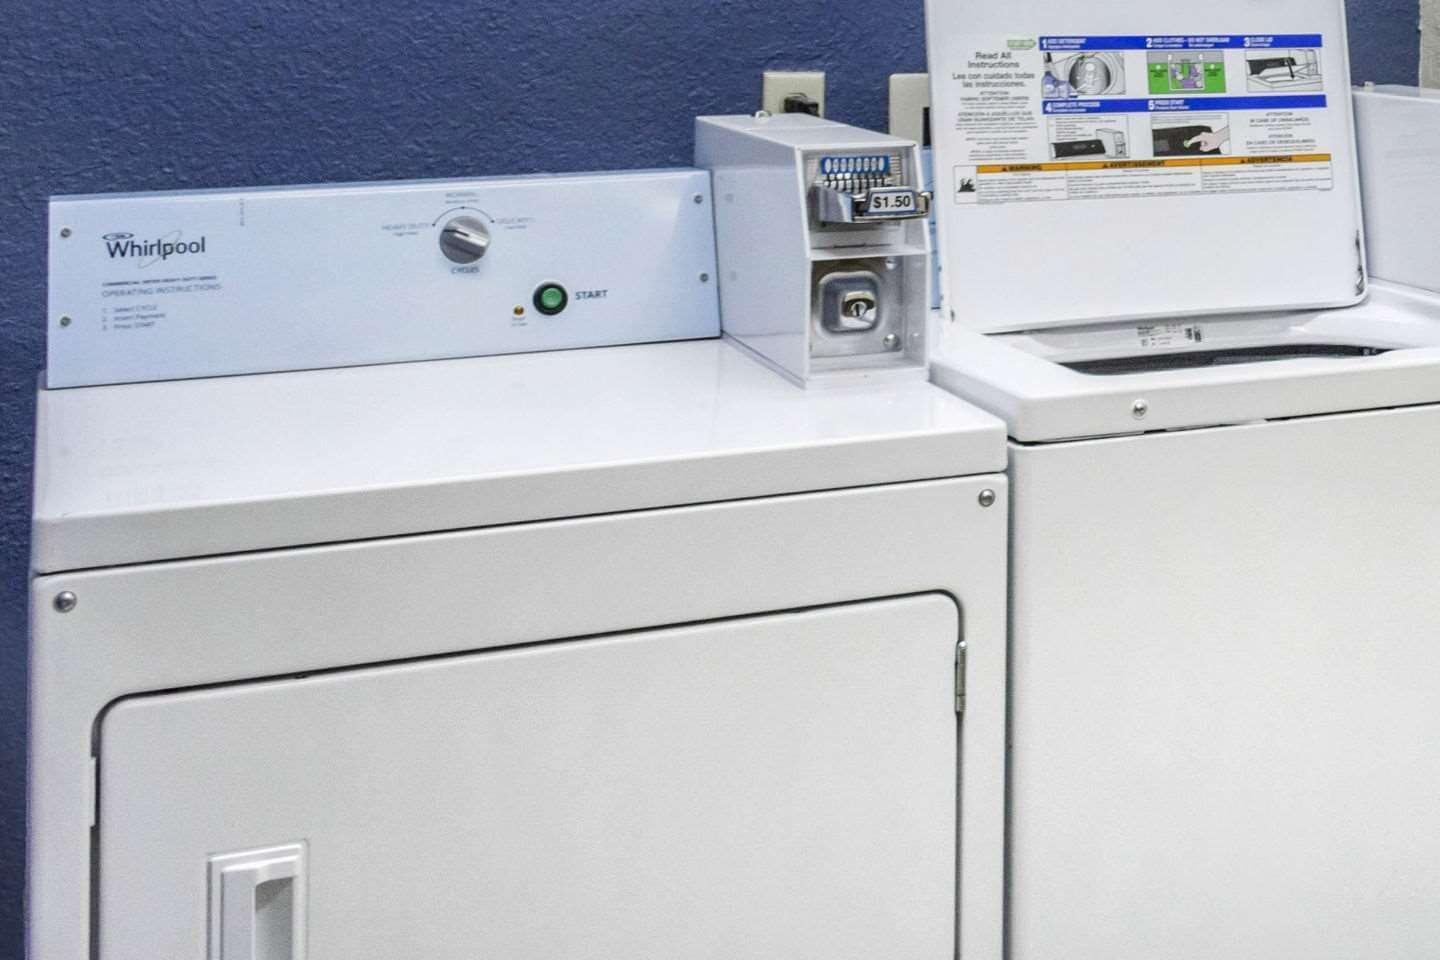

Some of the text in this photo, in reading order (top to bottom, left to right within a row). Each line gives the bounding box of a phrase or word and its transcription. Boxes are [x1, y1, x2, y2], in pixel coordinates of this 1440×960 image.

[1146, 38, 1152, 48] 2
[1045, 102, 1052, 112] 4
[873, 195, 911, 208] $1.50
[106, 236, 205, 260] Whirlpool
[576, 289, 608, 300] START
